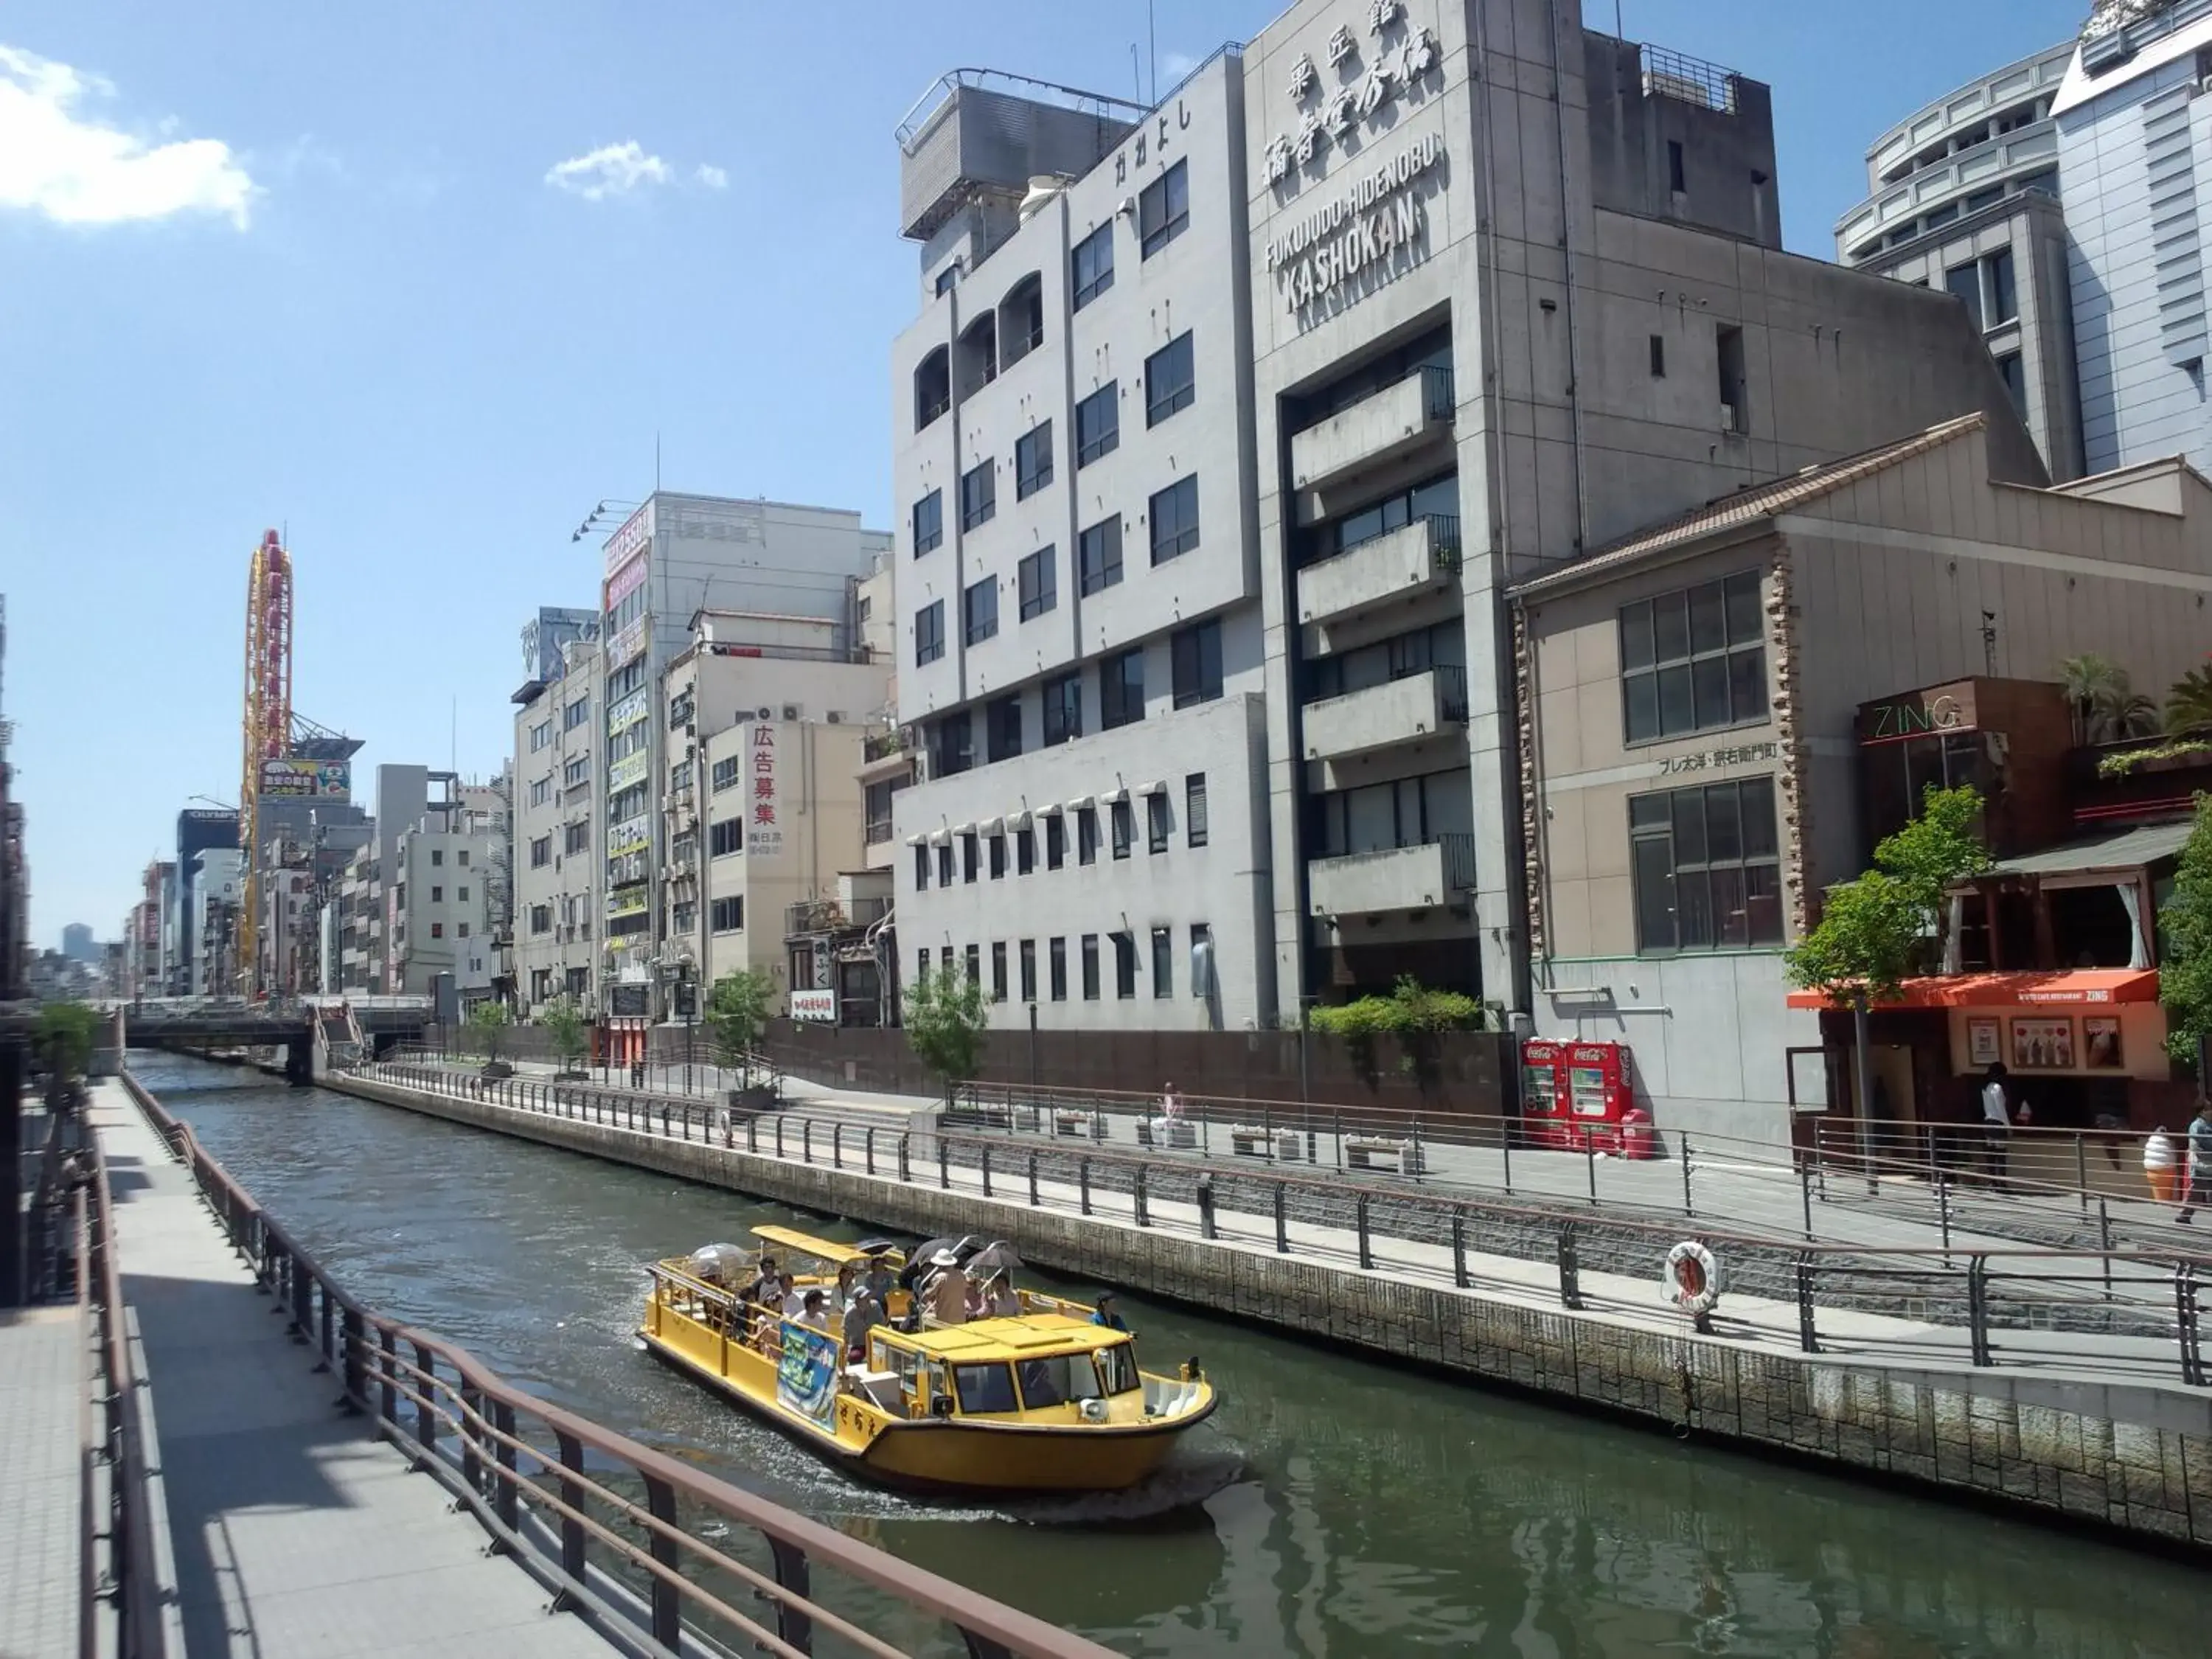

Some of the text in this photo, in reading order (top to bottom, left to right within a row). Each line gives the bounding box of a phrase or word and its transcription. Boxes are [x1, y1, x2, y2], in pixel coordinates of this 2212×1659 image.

[1282, 190, 1416, 316] KASHOKAN
[1874, 695, 1958, 738] ZING
[754, 725, 776, 827] 広告募集
